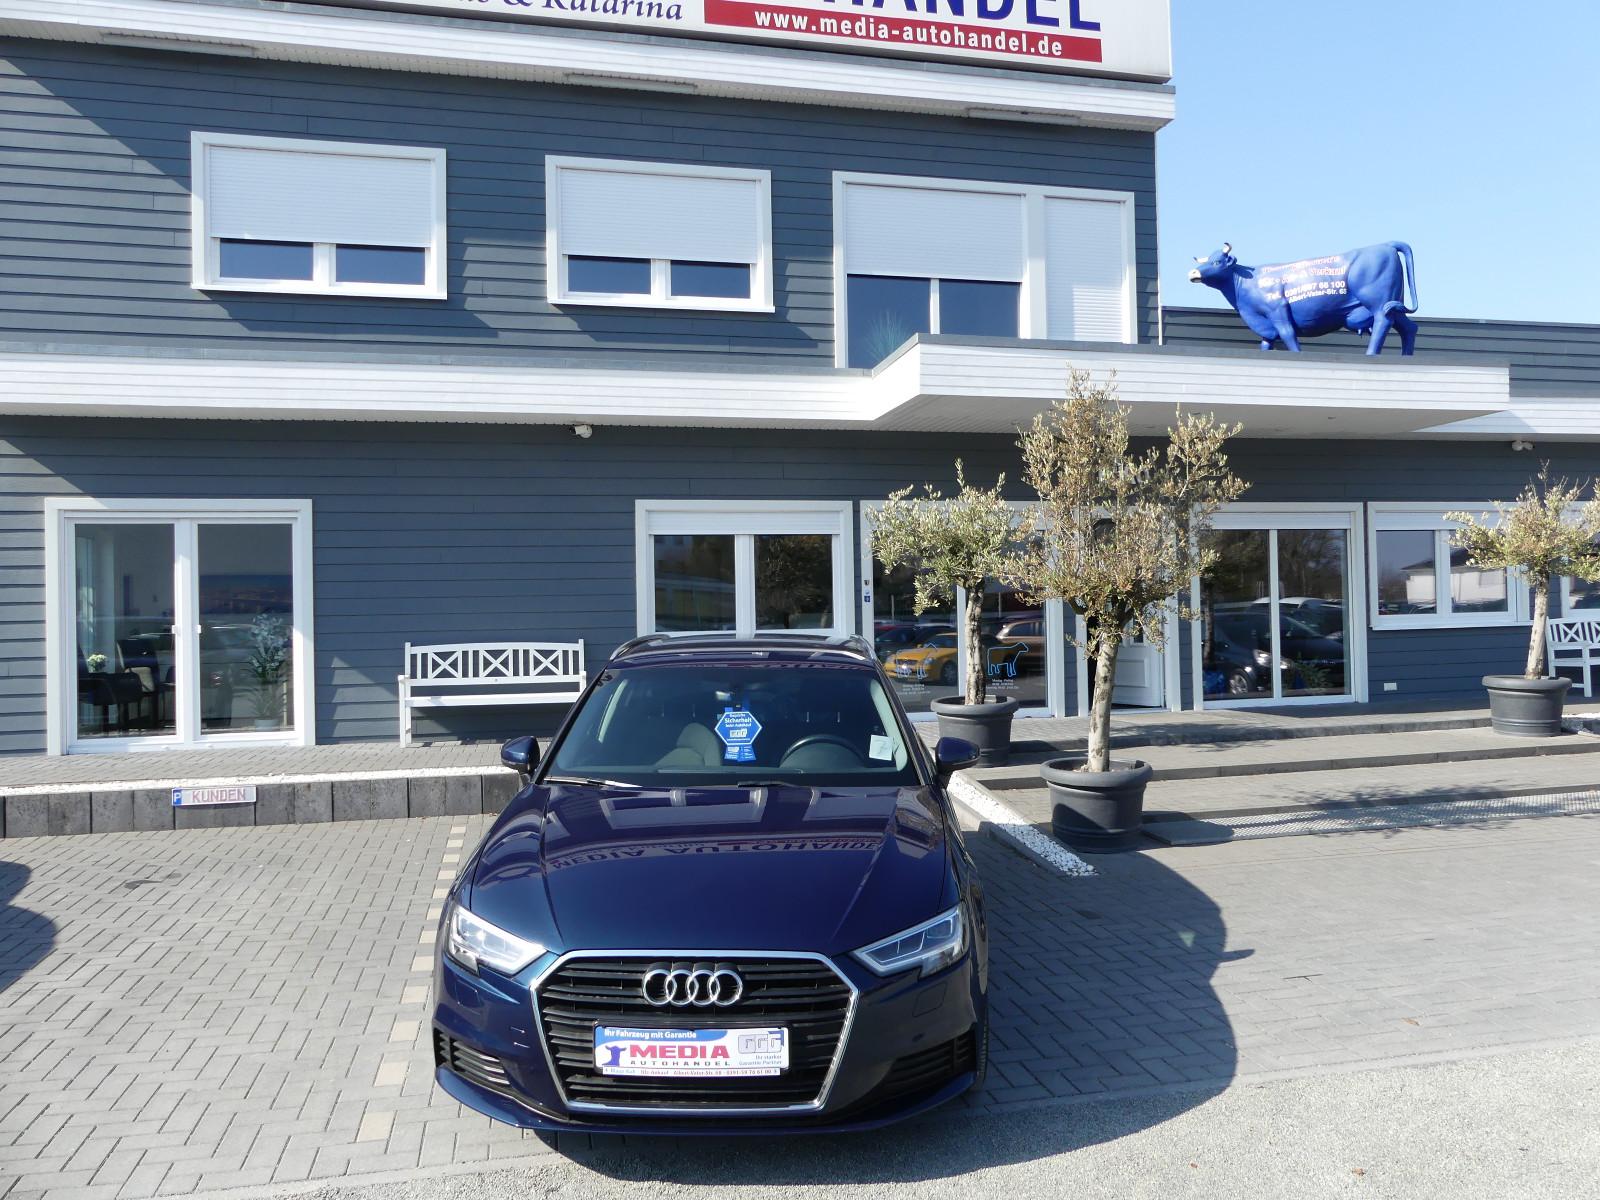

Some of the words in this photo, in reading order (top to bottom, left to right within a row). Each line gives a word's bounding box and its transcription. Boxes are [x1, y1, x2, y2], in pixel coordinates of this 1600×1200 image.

[755, 11, 1063, 56] www.media-autohandel.de
[1331, 281, 1345, 289] 100
[174, 792, 181, 802] P
[192, 788, 246, 803] KUNDEN
[604, 1029, 615, 1037] Ihr
[616, 1030, 650, 1039] Fahrzeug
[630, 1044, 730, 1058] MEDIA
